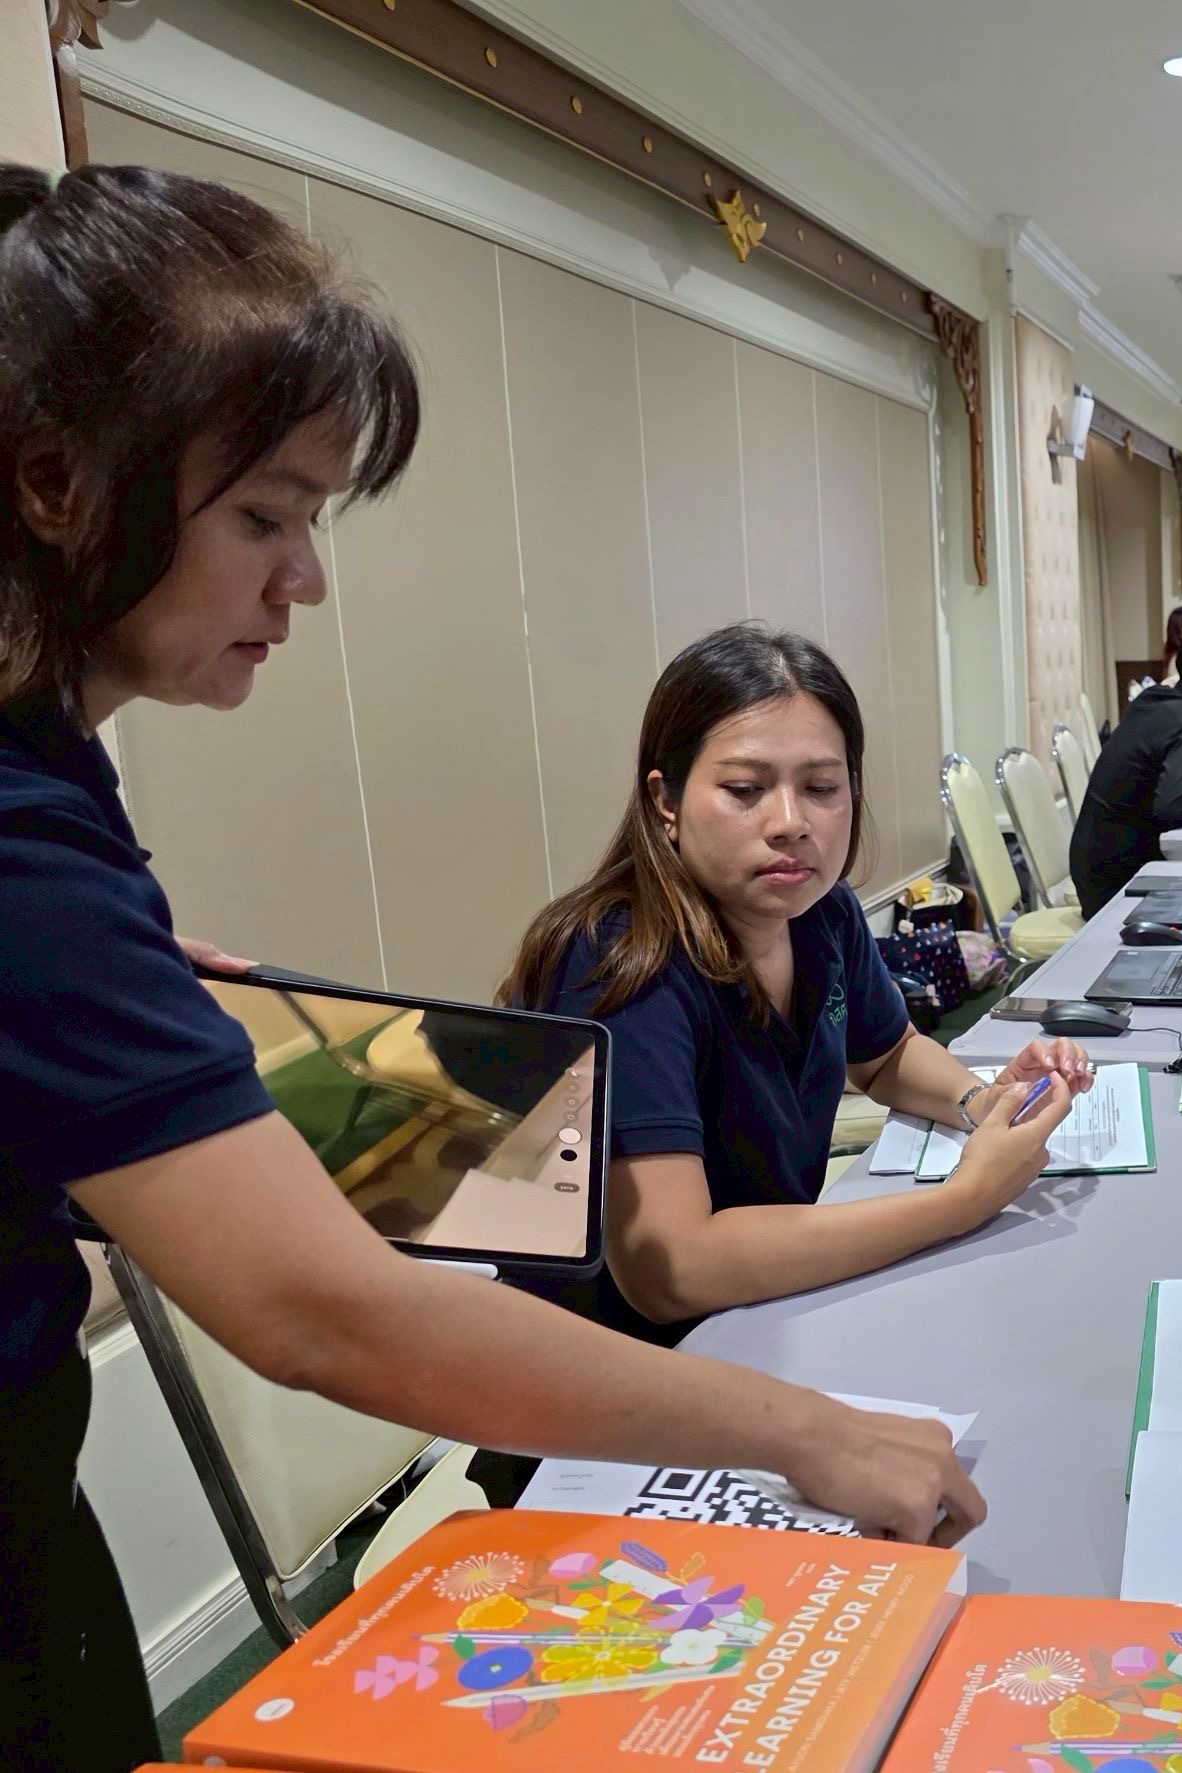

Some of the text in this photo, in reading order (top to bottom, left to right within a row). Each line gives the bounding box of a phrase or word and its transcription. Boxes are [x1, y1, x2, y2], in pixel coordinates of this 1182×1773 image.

[696, 1564, 851, 1763] EXTRAORDINARY
[743, 1562, 897, 1773] EARNING FOR ALL
[896, 1573, 915, 1595] WOOD
